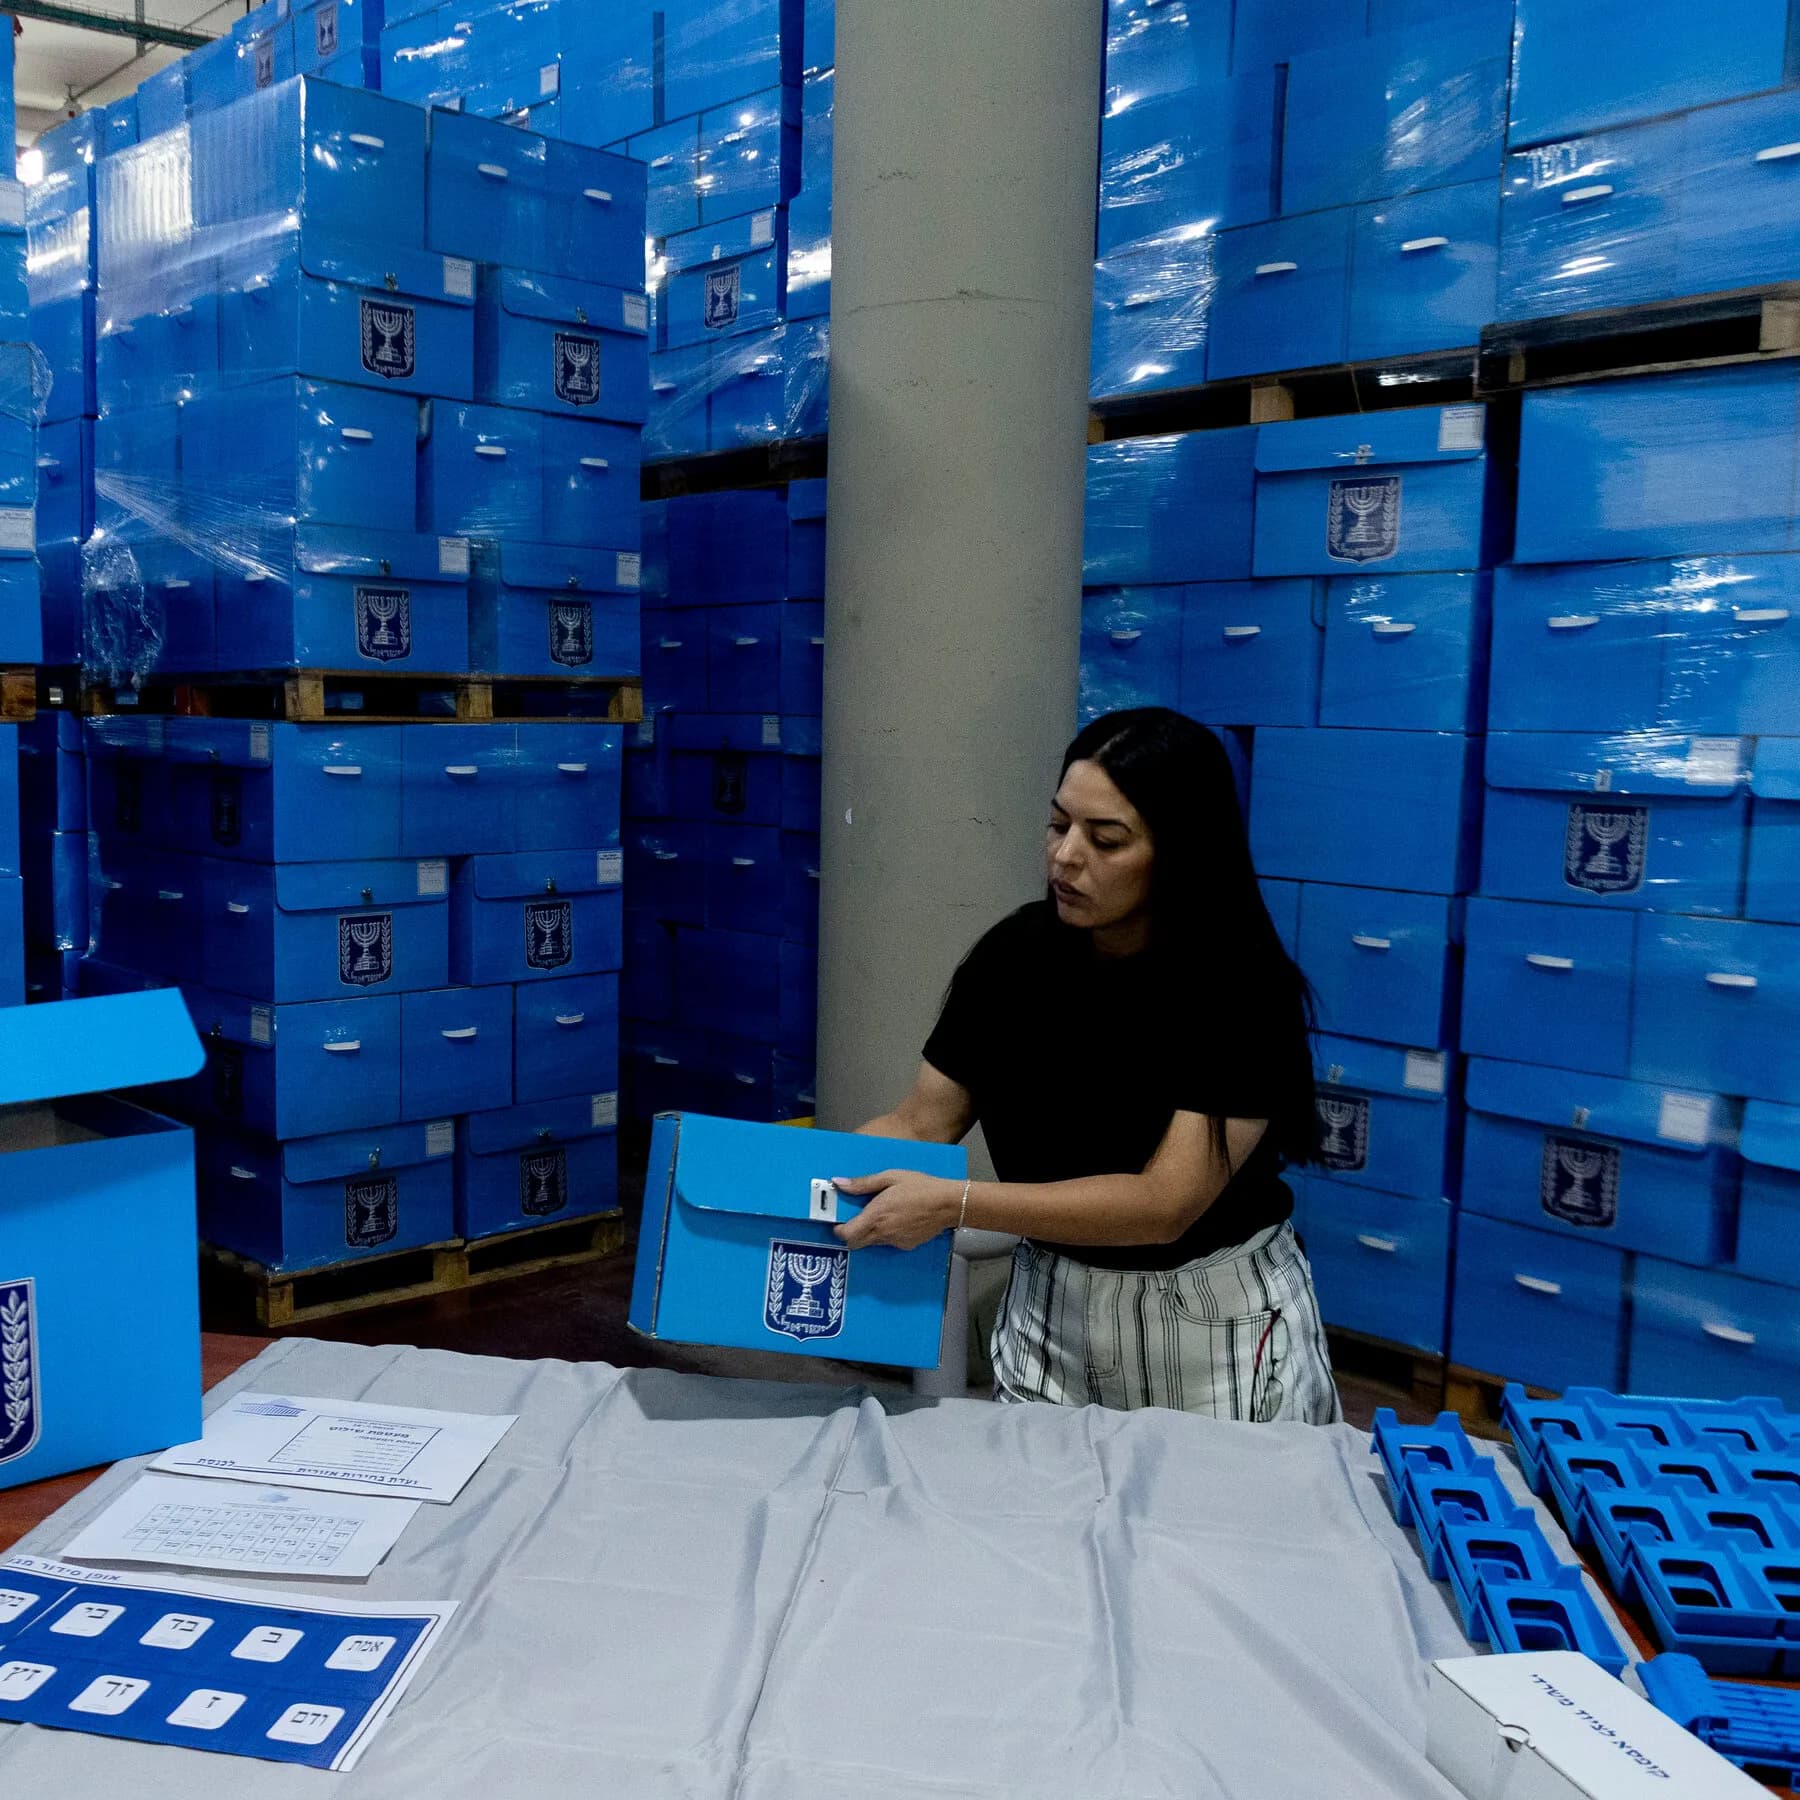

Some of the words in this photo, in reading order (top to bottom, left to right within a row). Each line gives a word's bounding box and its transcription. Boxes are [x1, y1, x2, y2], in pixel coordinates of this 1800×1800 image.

[780, 1314, 827, 1334] ישראל
[197, 1458, 235, 1467] לכנסת
[296, 1467, 337, 1477] אזורית
[341, 1471, 385, 1482] בחירות
[389, 1476, 418, 1485] ועדת
[40, 1562, 82, 1576] סידור
[85, 1571, 122, 1581] אופן
[85, 1606, 109, 1619] בי
[171, 1617, 199, 1632] בד
[261, 1631, 283, 1644] ב
[346, 1640, 385, 1653] אמת
[1530, 1673, 1575, 1706] משרדי
[1575, 1709, 1616, 1737] לציוד
[1611, 1740, 1671, 1778] קופסא
